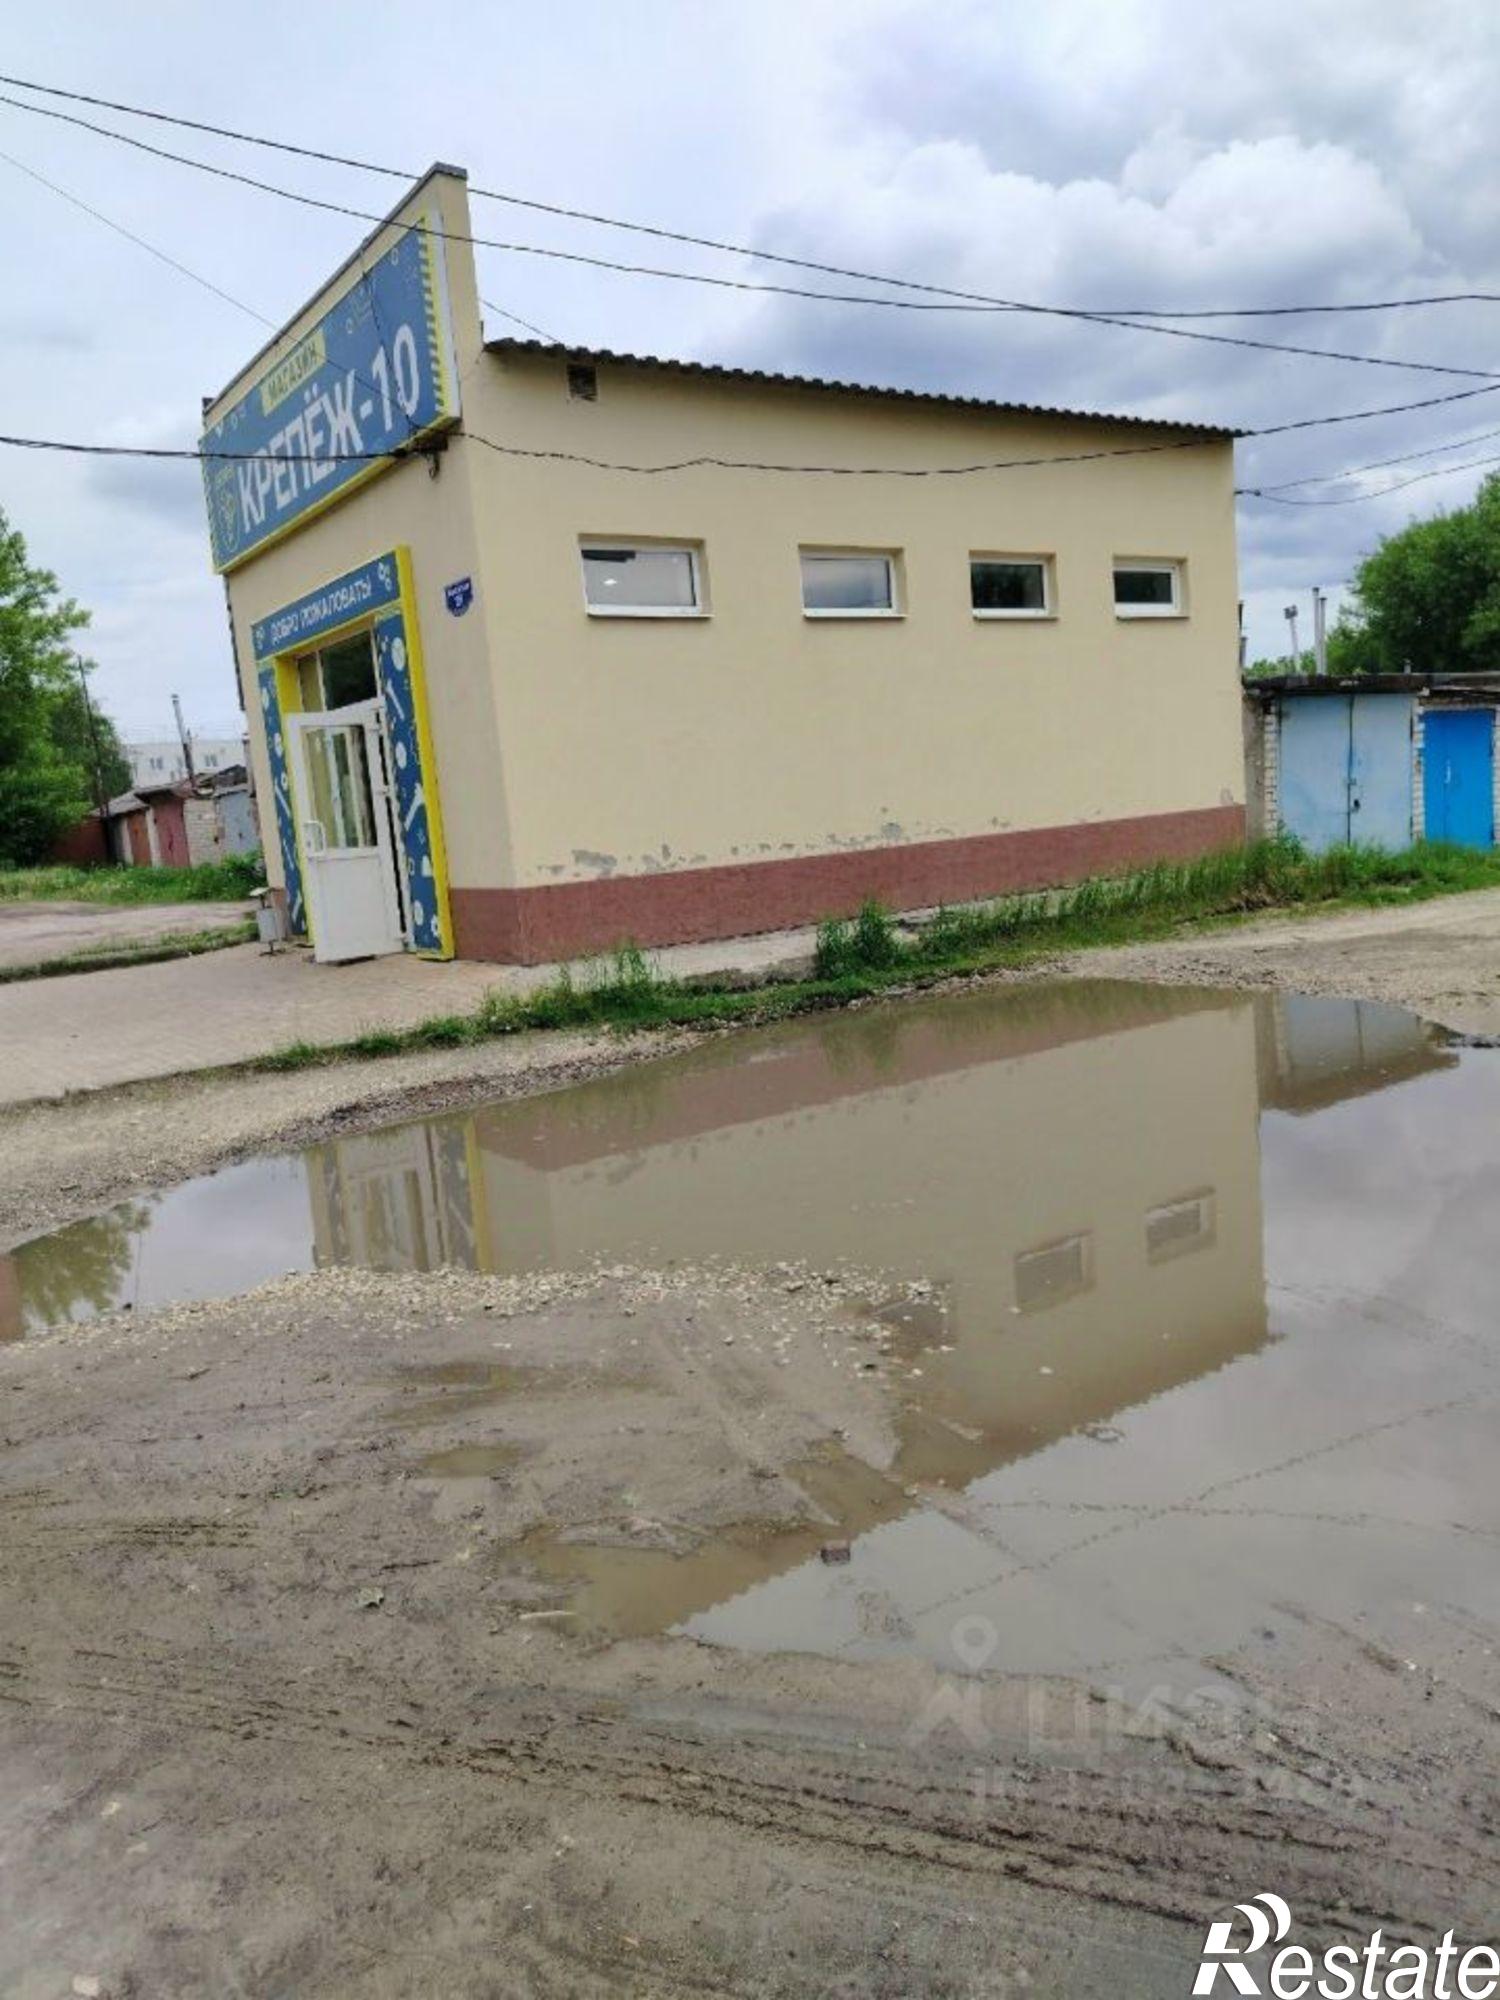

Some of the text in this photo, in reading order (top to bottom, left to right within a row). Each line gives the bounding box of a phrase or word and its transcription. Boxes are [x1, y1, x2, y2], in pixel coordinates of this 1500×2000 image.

[267, 338, 318, 400] МАГАЗИН
[237, 323, 420, 534] КРЕПЁЖ-10
[270, 612, 299, 646] ДОБРО
